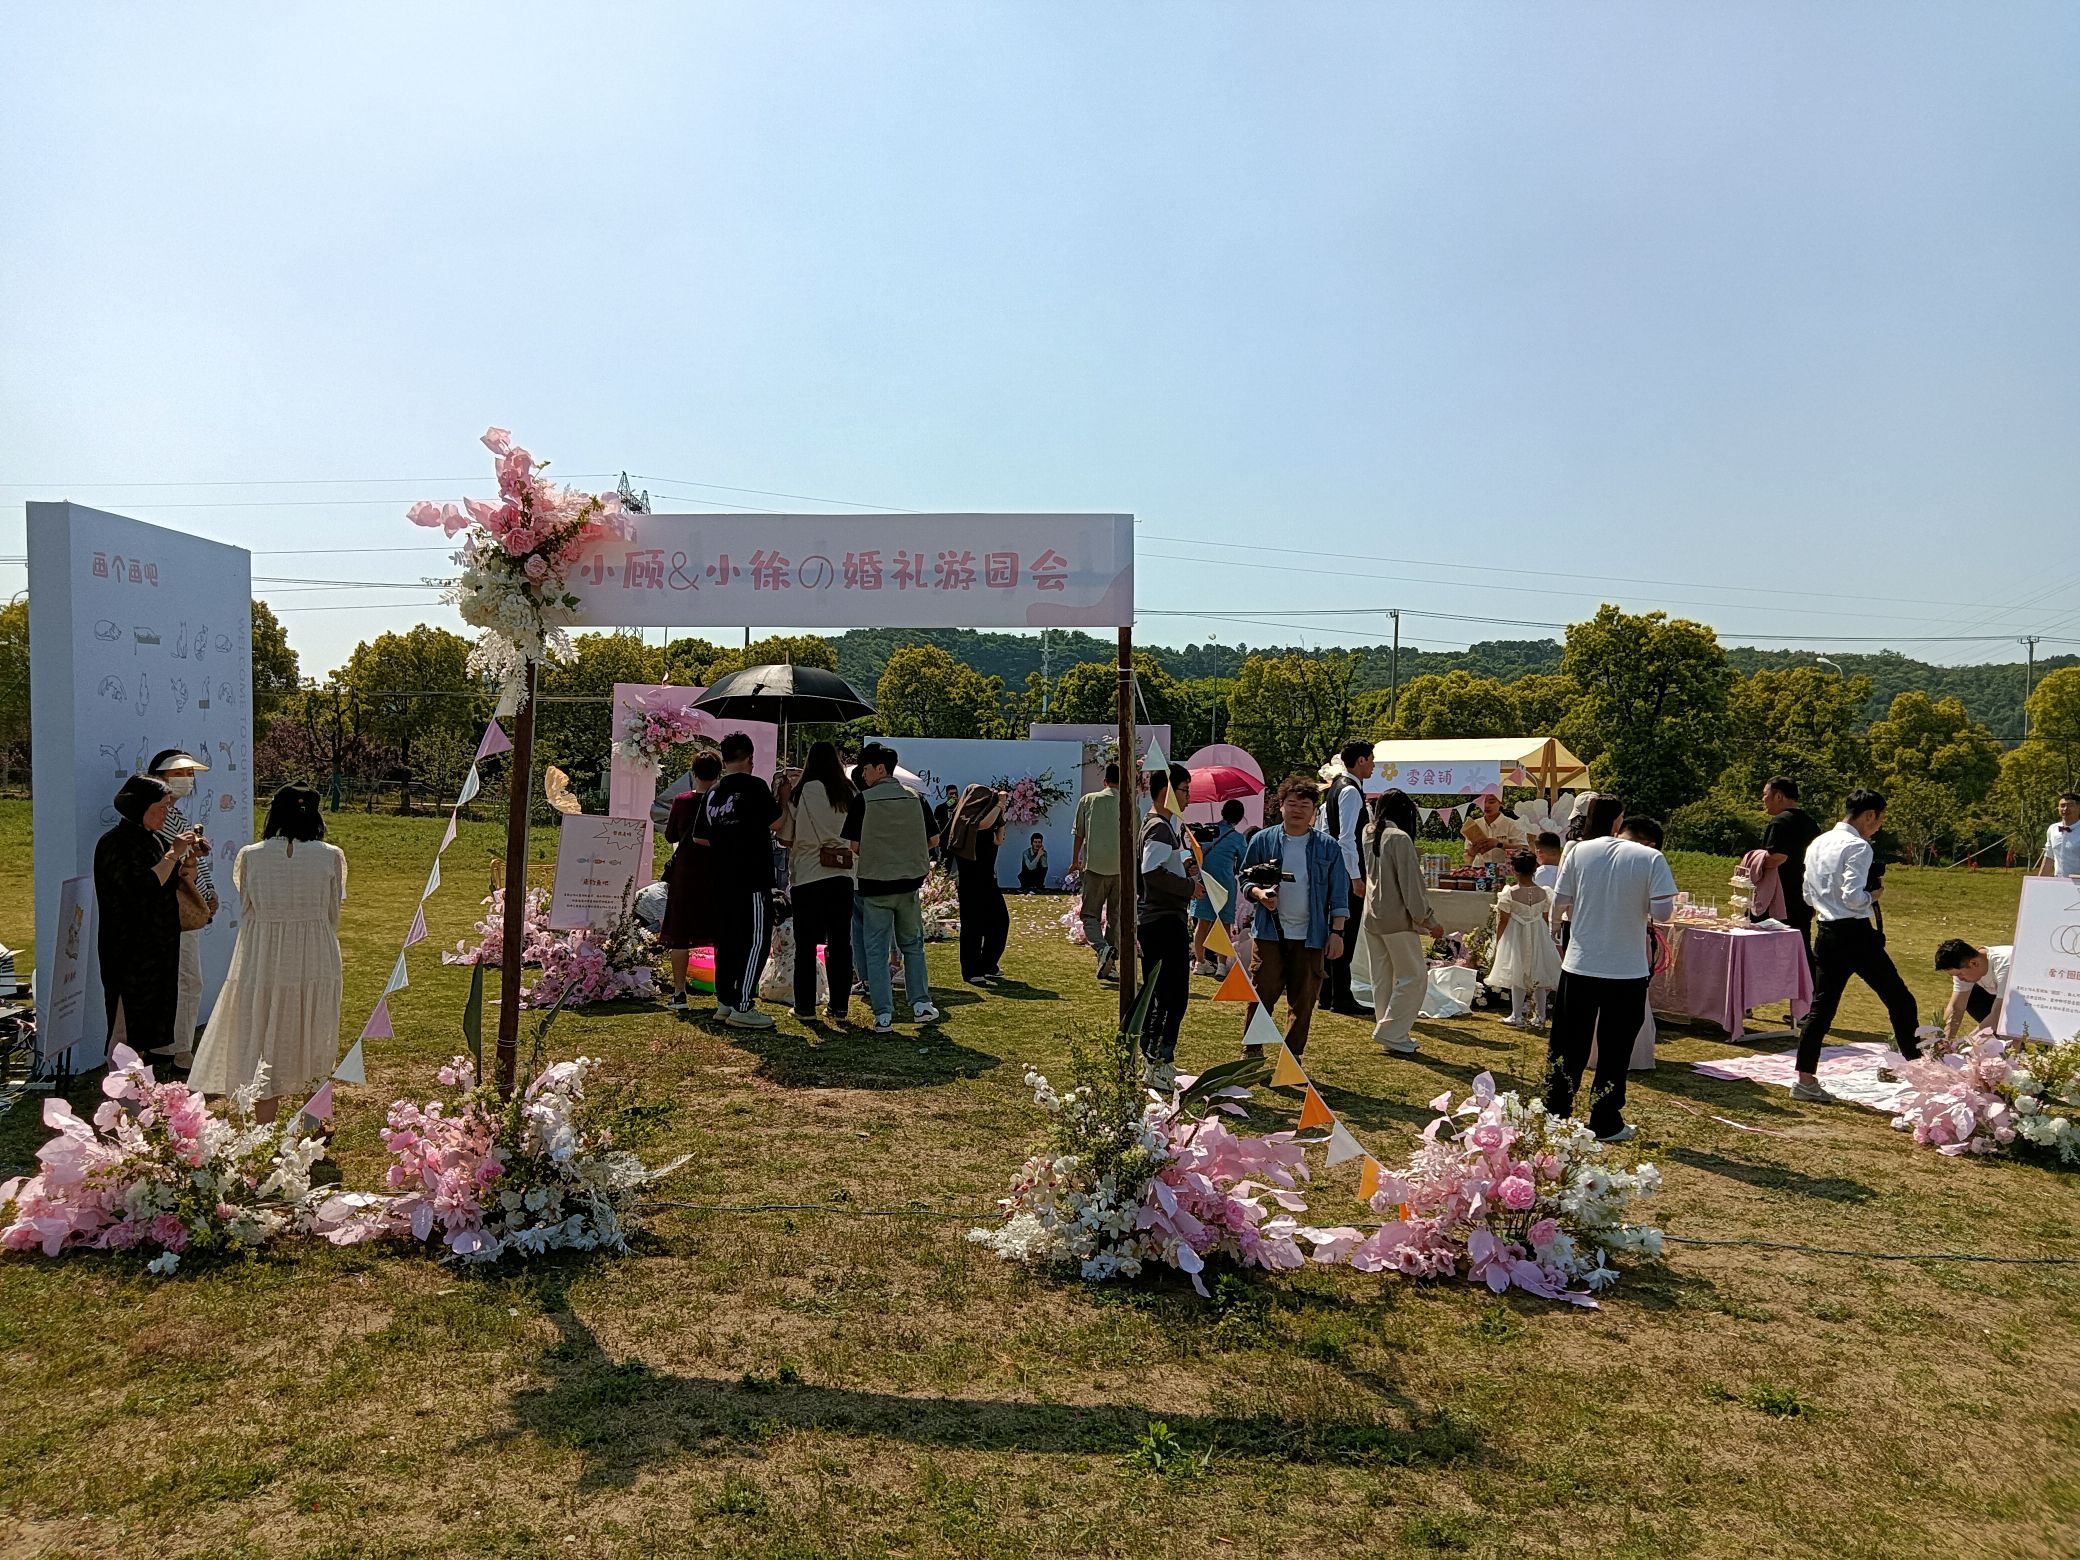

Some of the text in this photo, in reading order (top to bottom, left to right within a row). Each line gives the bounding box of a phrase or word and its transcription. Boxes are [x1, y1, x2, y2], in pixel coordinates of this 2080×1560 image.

[92, 551, 159, 587] 画个画吧
[580, 549, 1068, 591] 小顾&小徐の婚礼游园会
[238, 617, 247, 709] WELCOME
[240, 716, 247, 738] TO
[1406, 768, 1453, 786] 零食铺
[932, 785, 948, 801] X
